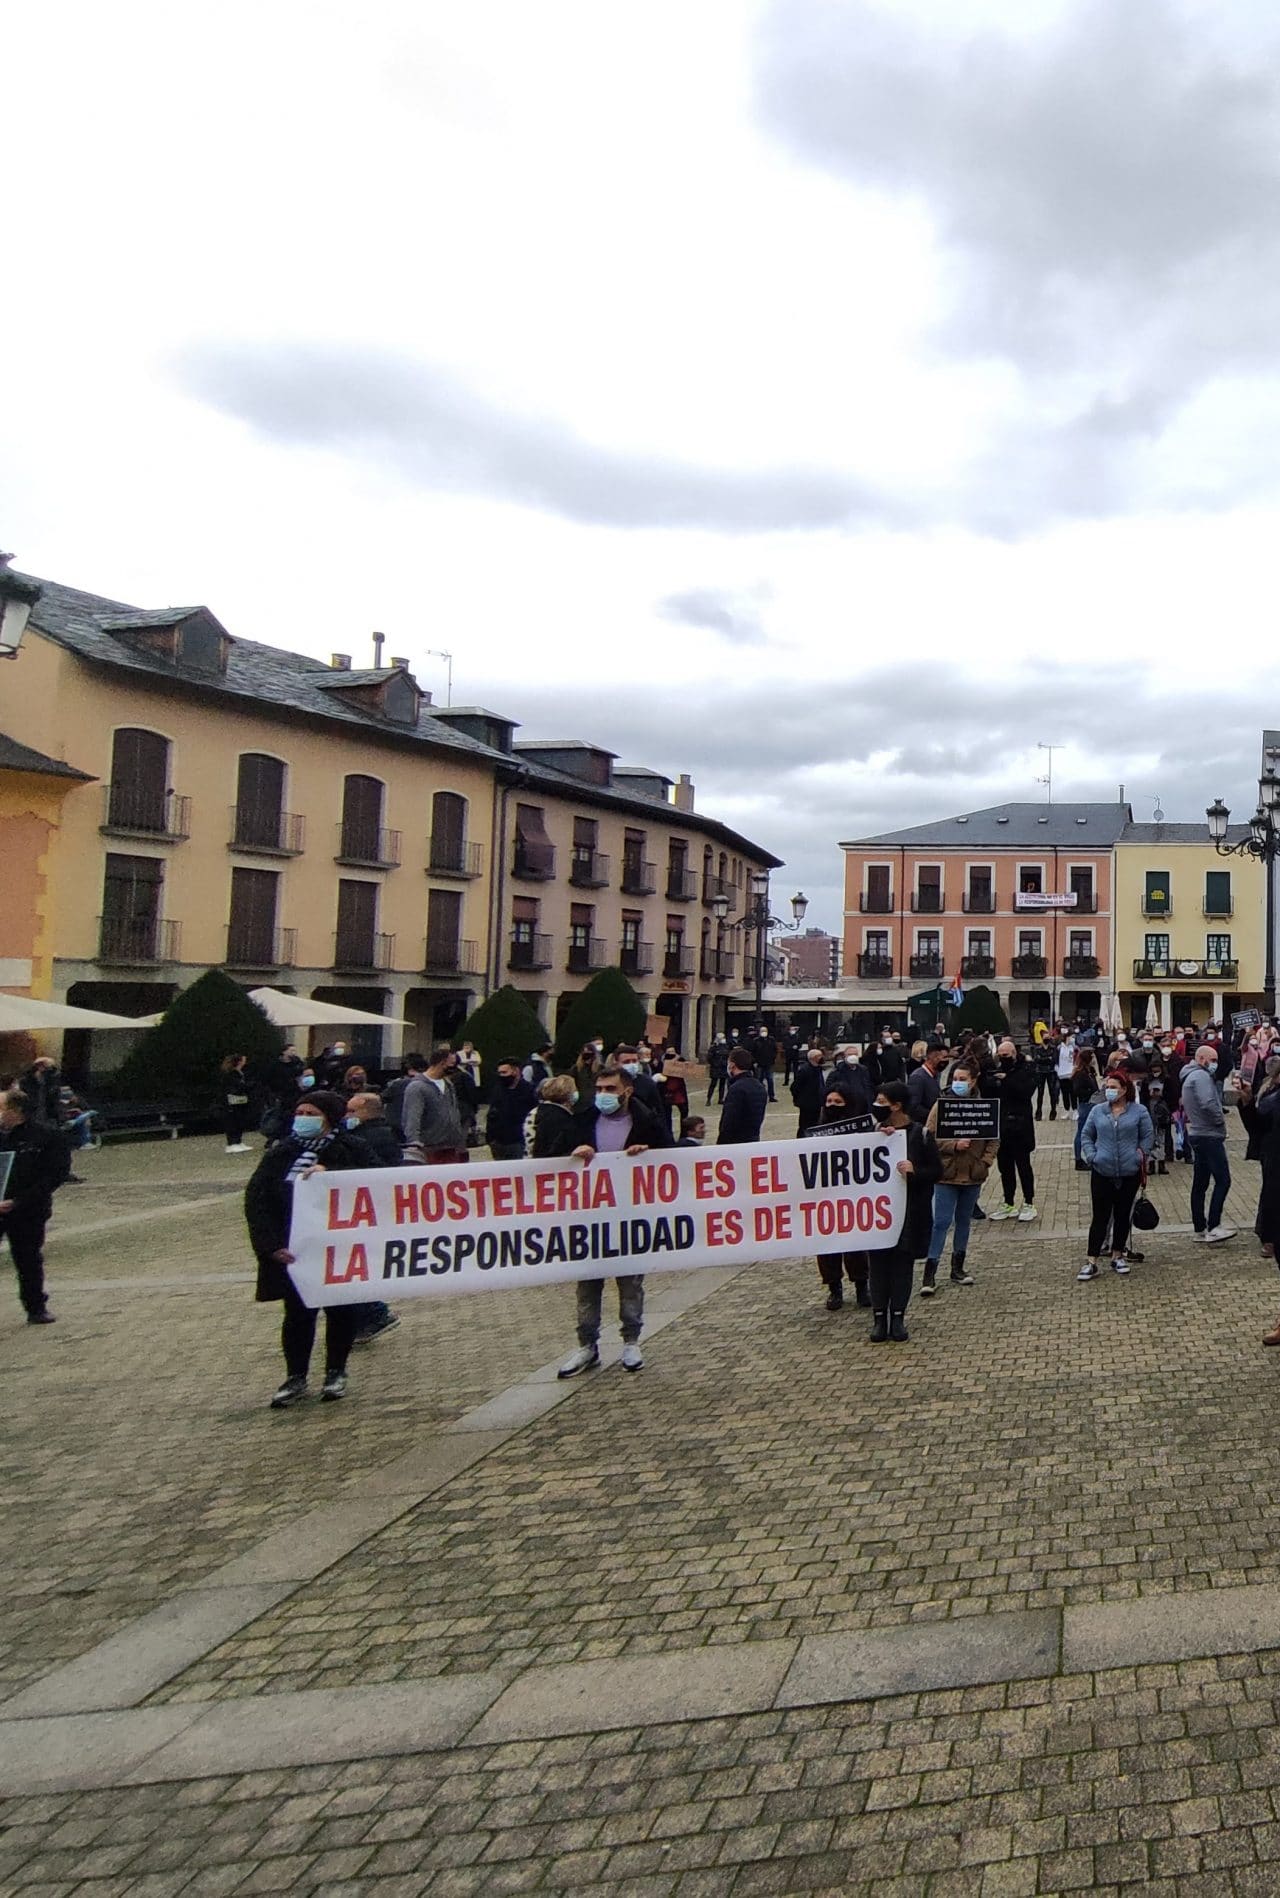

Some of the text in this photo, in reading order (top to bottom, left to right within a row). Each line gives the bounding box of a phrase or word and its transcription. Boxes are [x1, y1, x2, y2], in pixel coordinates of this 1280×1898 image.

[327, 1145, 891, 1231] LA HOSTELERÍA NO ES EL VIRUS
[324, 1195, 893, 1285] LA RESPONSABILIDAD ES DE TODOS
